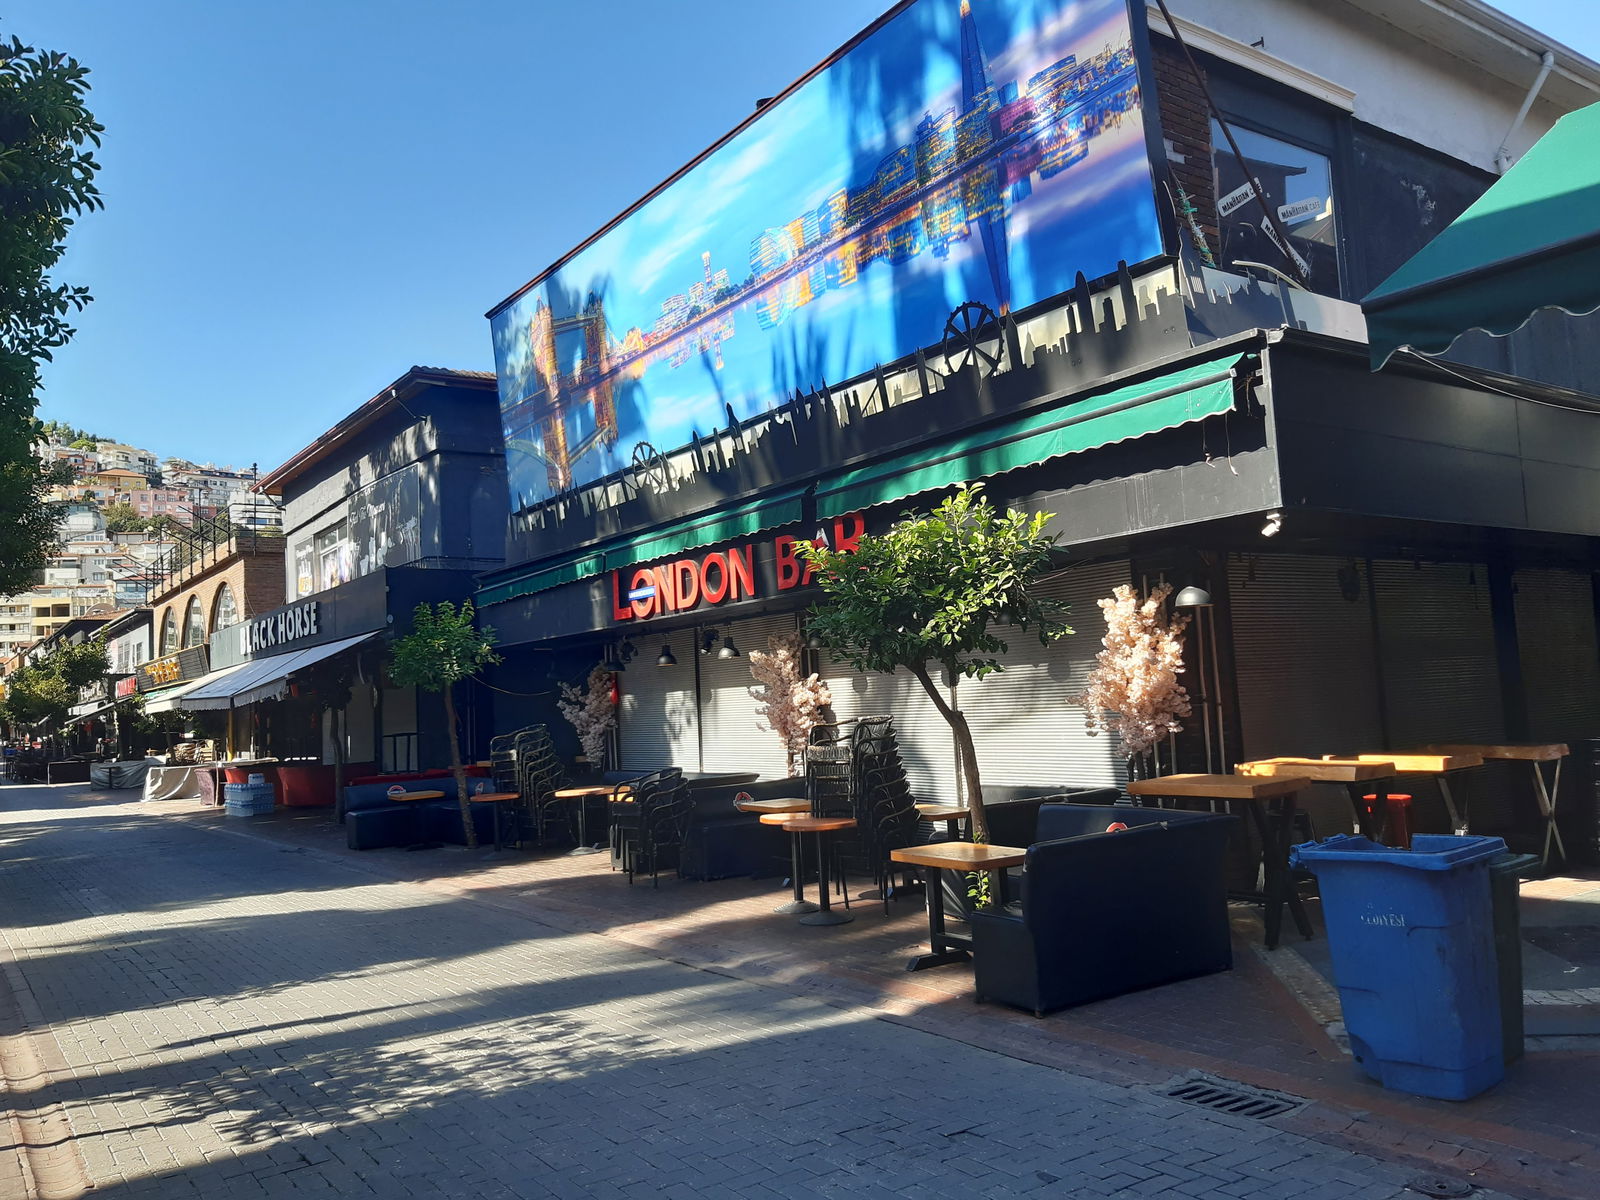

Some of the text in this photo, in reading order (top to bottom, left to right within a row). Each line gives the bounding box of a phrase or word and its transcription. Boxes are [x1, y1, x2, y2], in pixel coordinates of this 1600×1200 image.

[612, 544, 754, 620] LONDON
[239, 601, 318, 656] BLACK HORSE
